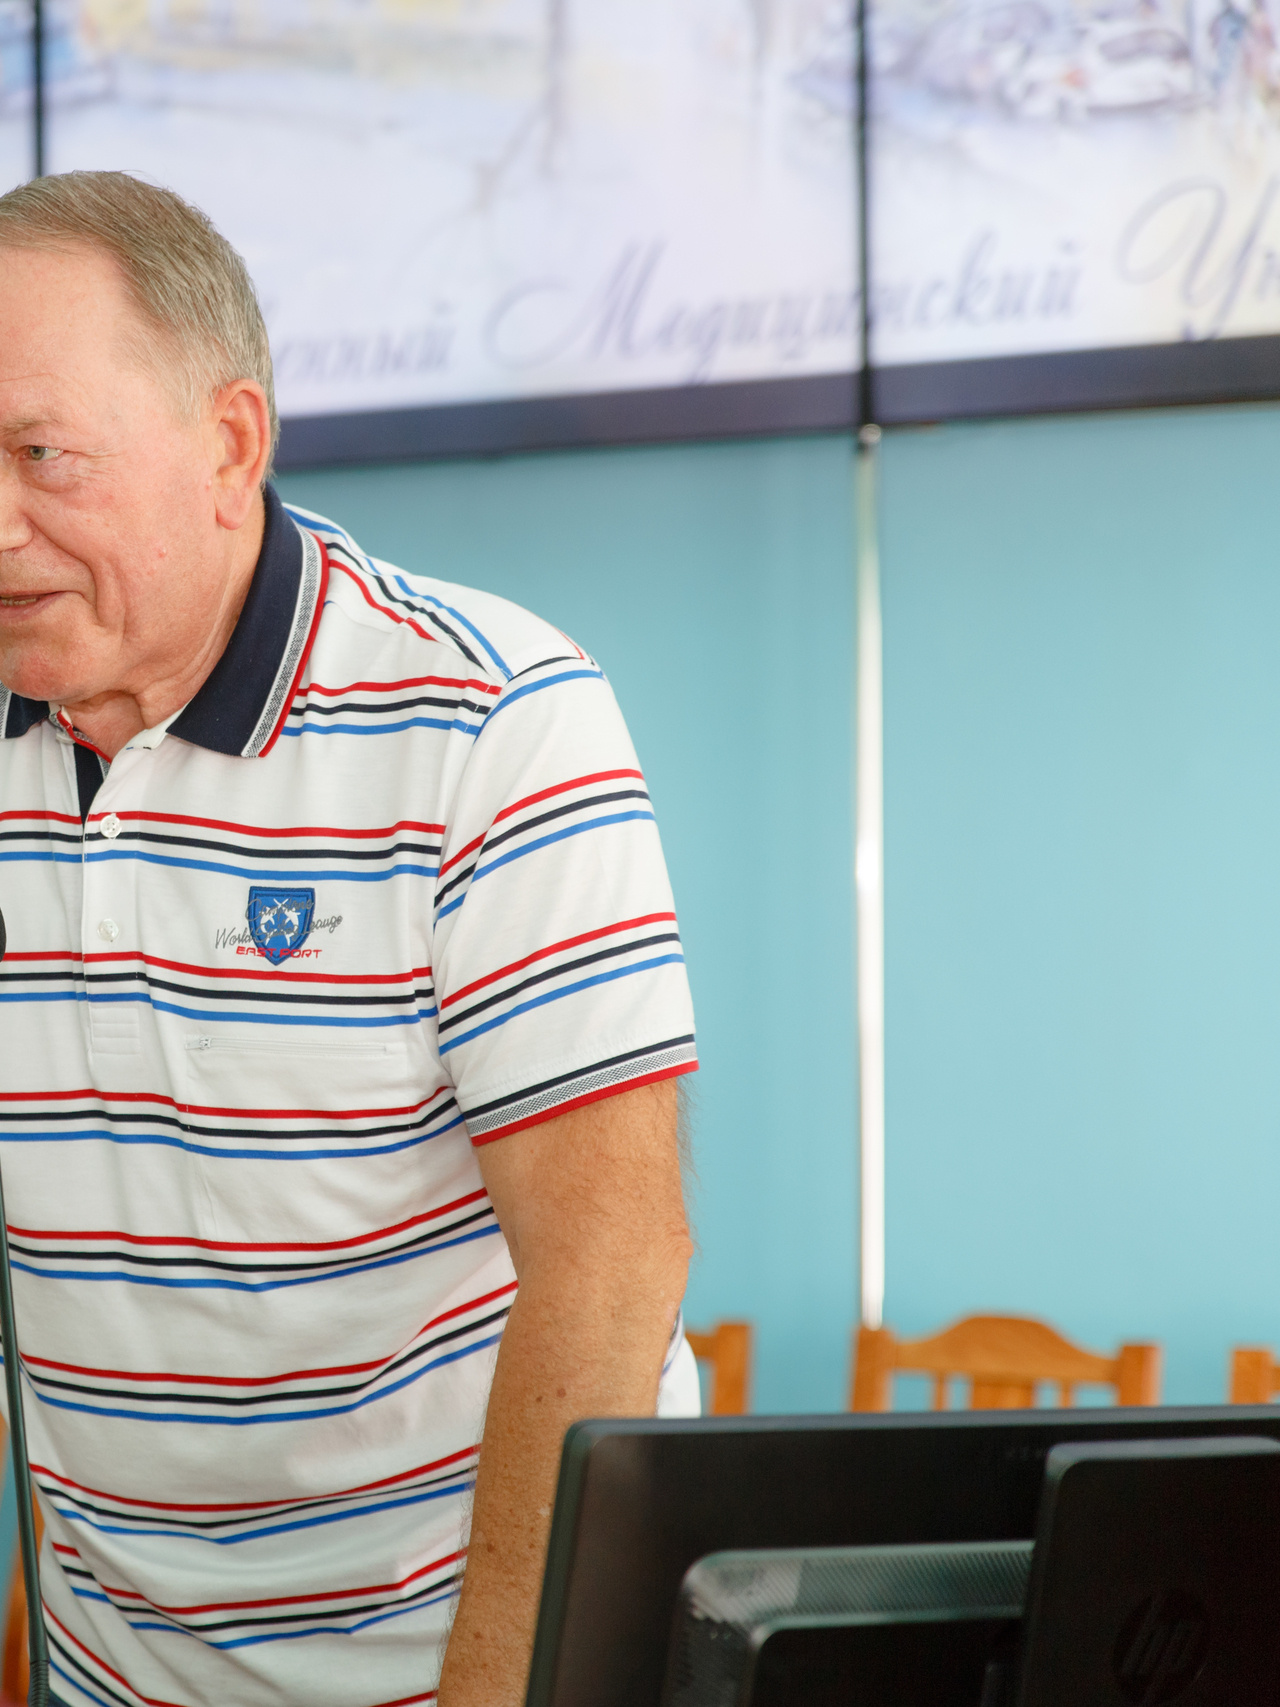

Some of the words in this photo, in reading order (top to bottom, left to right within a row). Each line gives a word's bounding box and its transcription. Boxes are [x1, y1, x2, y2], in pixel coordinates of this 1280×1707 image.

[214, 926, 254, 949] World
[236, 945, 277, 958] EAST
[279, 947, 323, 959] PORT
